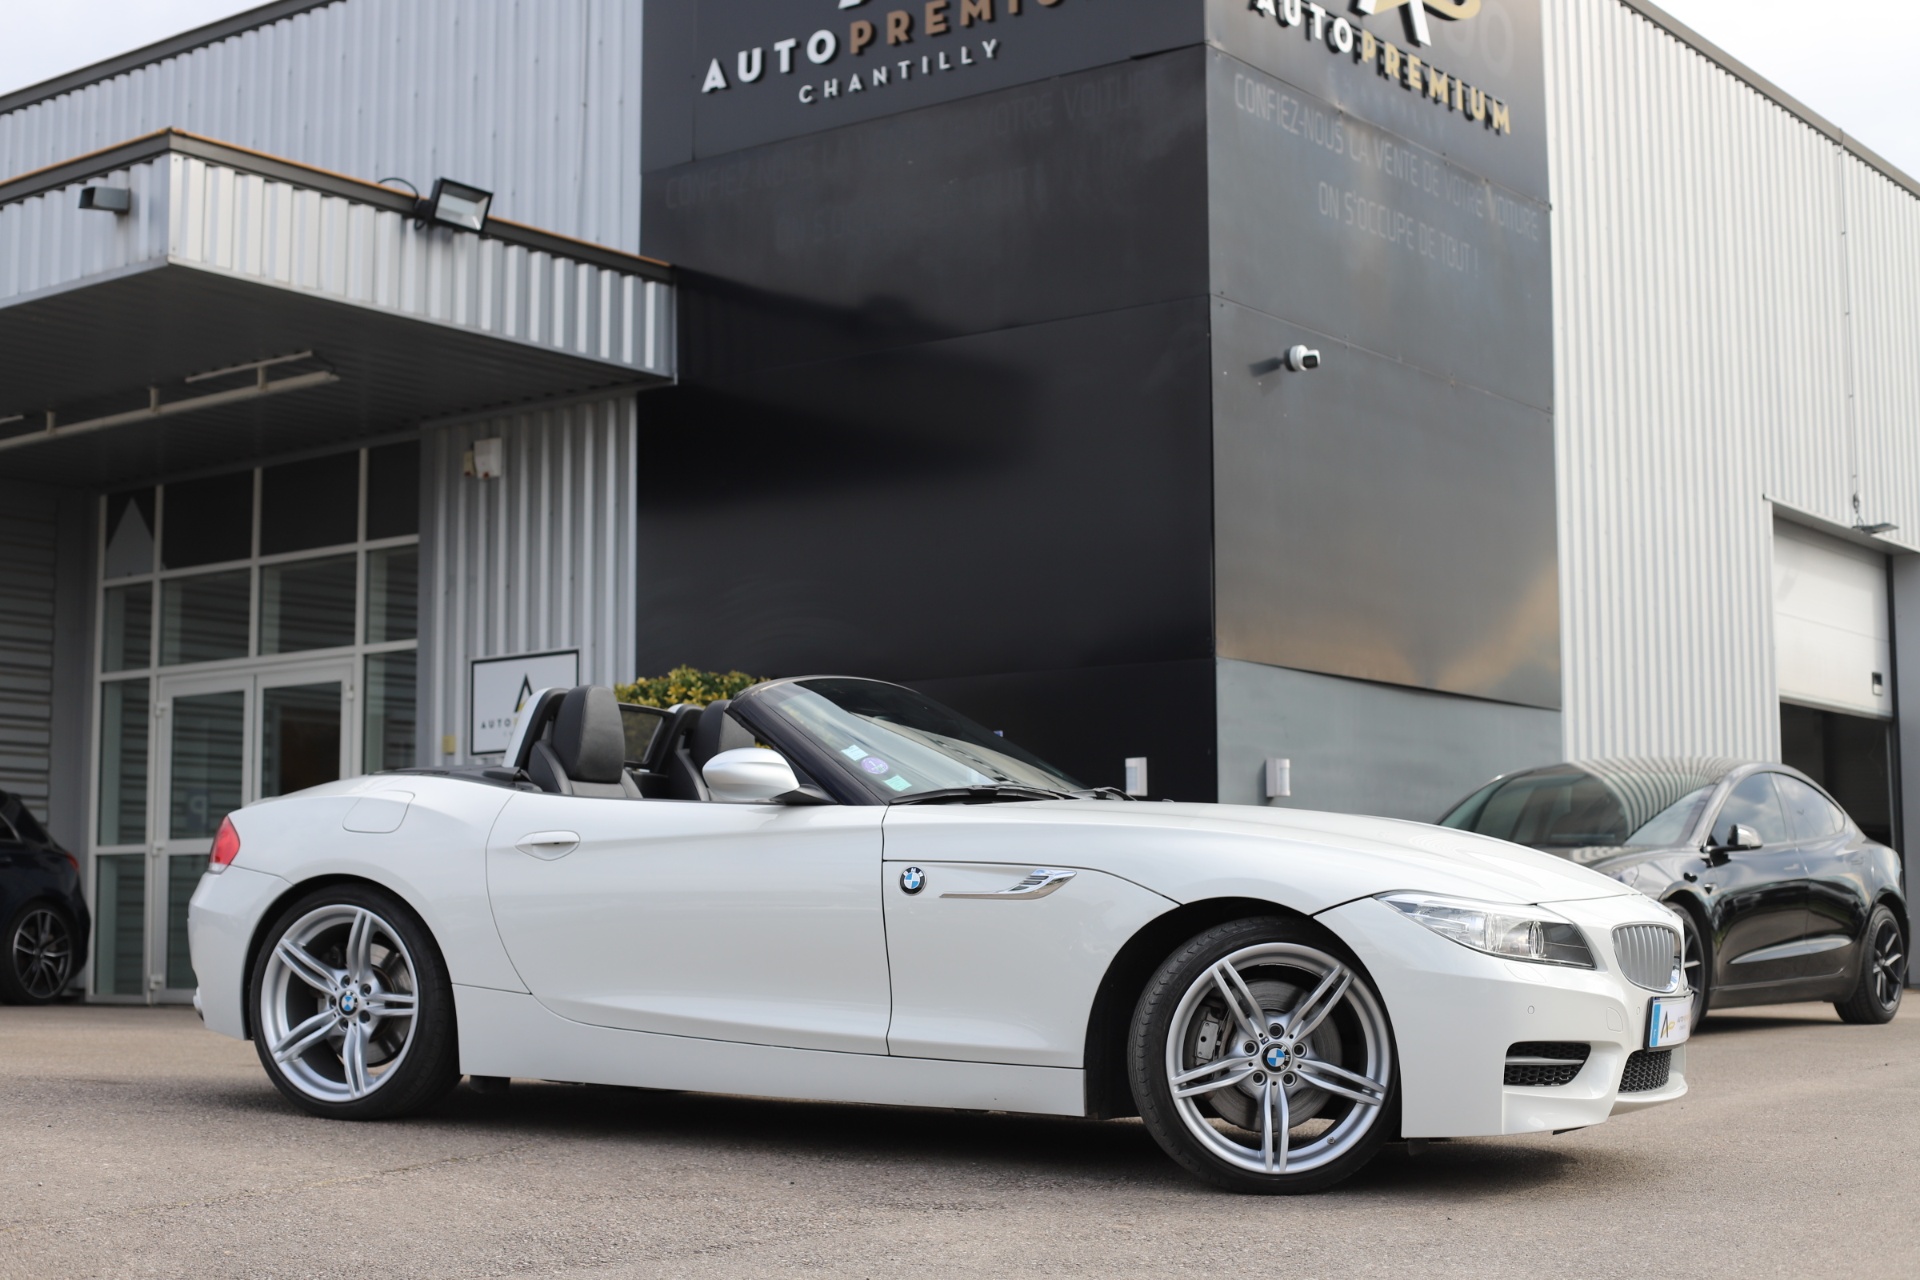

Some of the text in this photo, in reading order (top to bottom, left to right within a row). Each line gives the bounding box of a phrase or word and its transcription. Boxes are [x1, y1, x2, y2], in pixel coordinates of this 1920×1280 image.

[702, 0, 1062, 93] AUTOPREM
[799, 39, 997, 104] CHANTILLY
[1234, 73, 1344, 156] CONFIEZ-NOUS
[1347, 127, 1373, 168] LA
[1374, 132, 1419, 189] VENTE
[1422, 158, 1440, 199] DE
[1443, 170, 1484, 219] VOTRE
[1318, 180, 1339, 221] ON
[1344, 189, 1415, 252] S'OCCUPE
[1418, 221, 1436, 261] DE
[1440, 230, 1470, 274] TOUT
